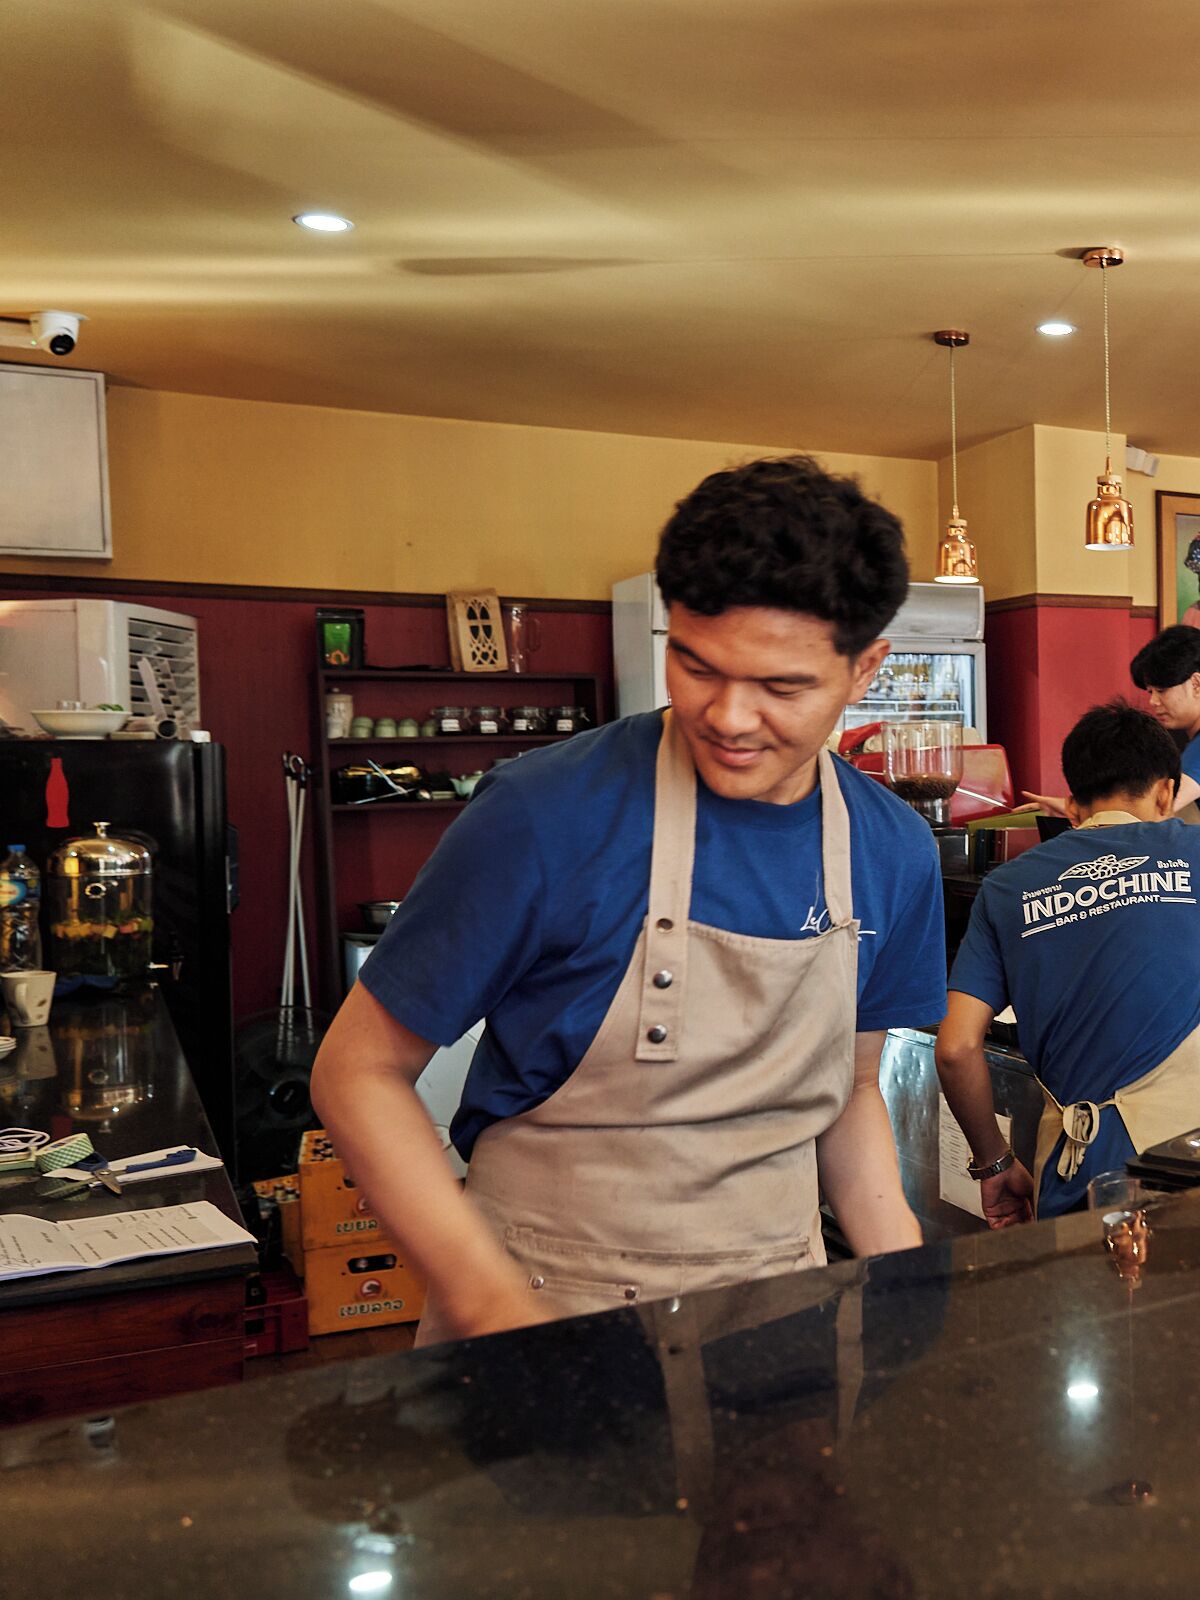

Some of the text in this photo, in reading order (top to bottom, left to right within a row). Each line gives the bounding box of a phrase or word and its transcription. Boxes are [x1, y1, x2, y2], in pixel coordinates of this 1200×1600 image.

[1022, 870, 1192, 925] INDOCHINE
[1055, 894, 1161, 927] BAR & RESTAURANT
[336, 1219, 378, 1233] ເບຍລ
